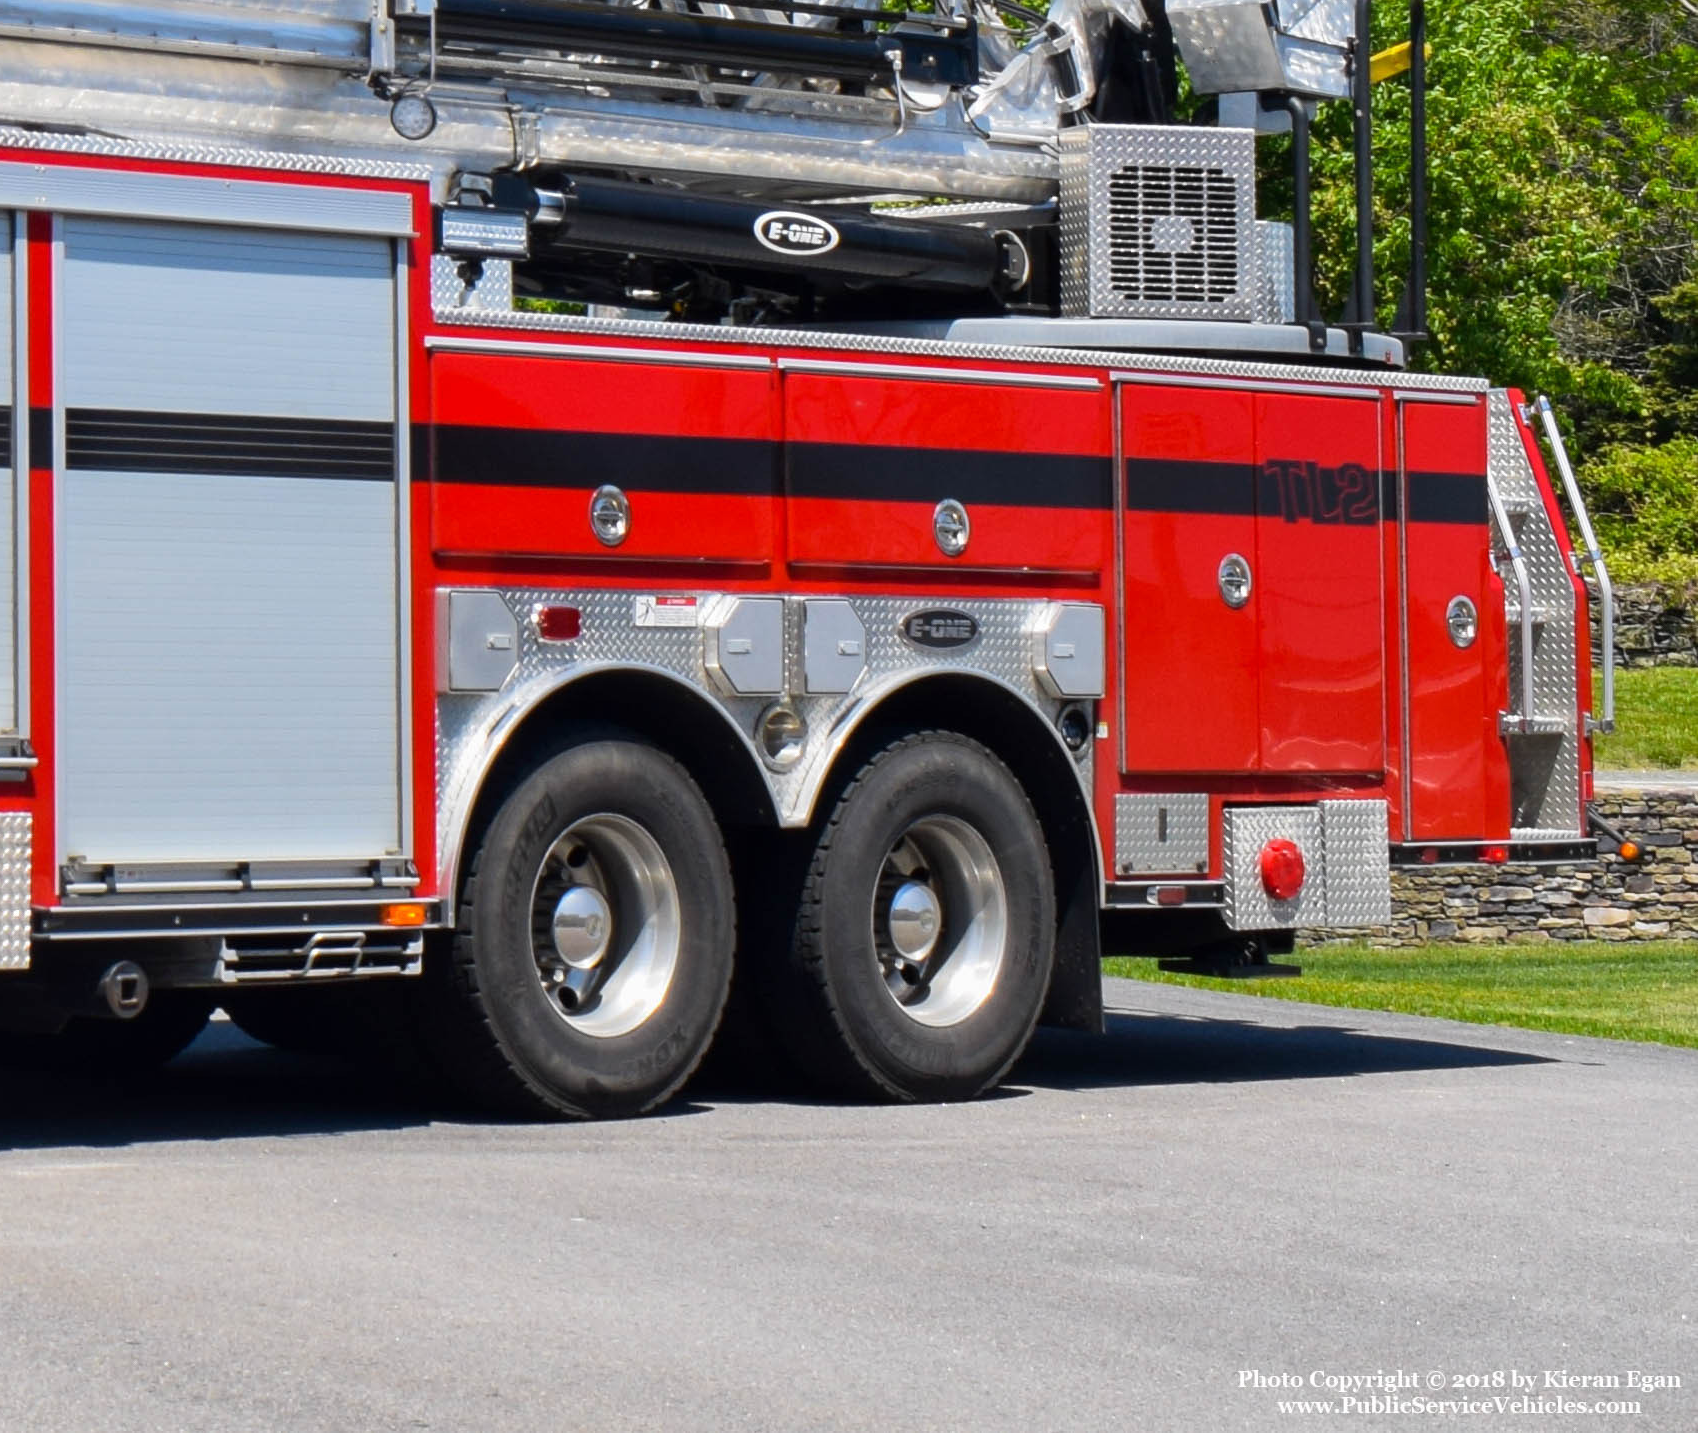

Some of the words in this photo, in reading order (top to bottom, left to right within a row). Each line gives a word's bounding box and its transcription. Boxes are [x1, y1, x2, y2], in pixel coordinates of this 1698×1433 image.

[768, 221, 825, 245] E-ONE
[1264, 459, 1377, 526] TL2
[909, 618, 972, 639] E-ONE
